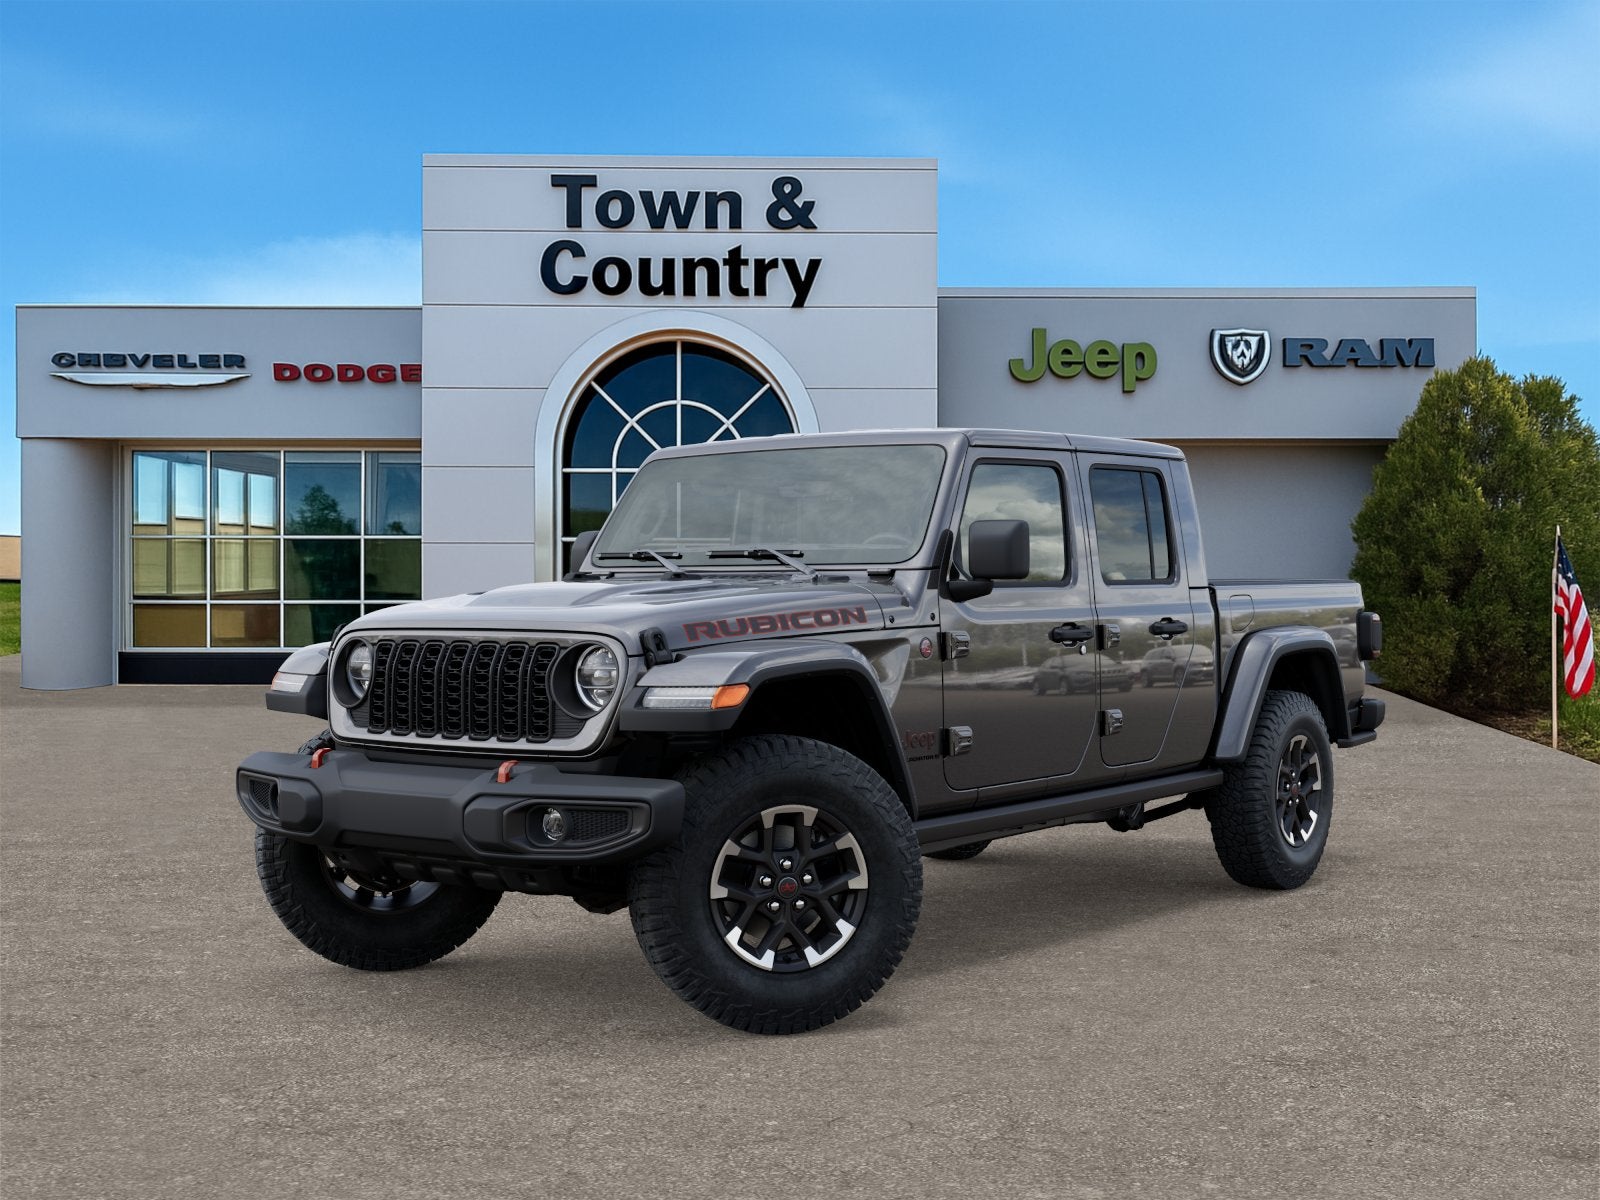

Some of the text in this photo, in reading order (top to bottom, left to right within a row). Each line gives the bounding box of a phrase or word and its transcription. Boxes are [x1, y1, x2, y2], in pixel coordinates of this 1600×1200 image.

[550, 174, 818, 229] Town &
[540, 240, 823, 308] Country
[273, 362, 422, 383] DODGE
[1009, 328, 1157, 393] Jeep
[1282, 337, 1436, 368] RAM
[682, 606, 868, 643] RUBICON
